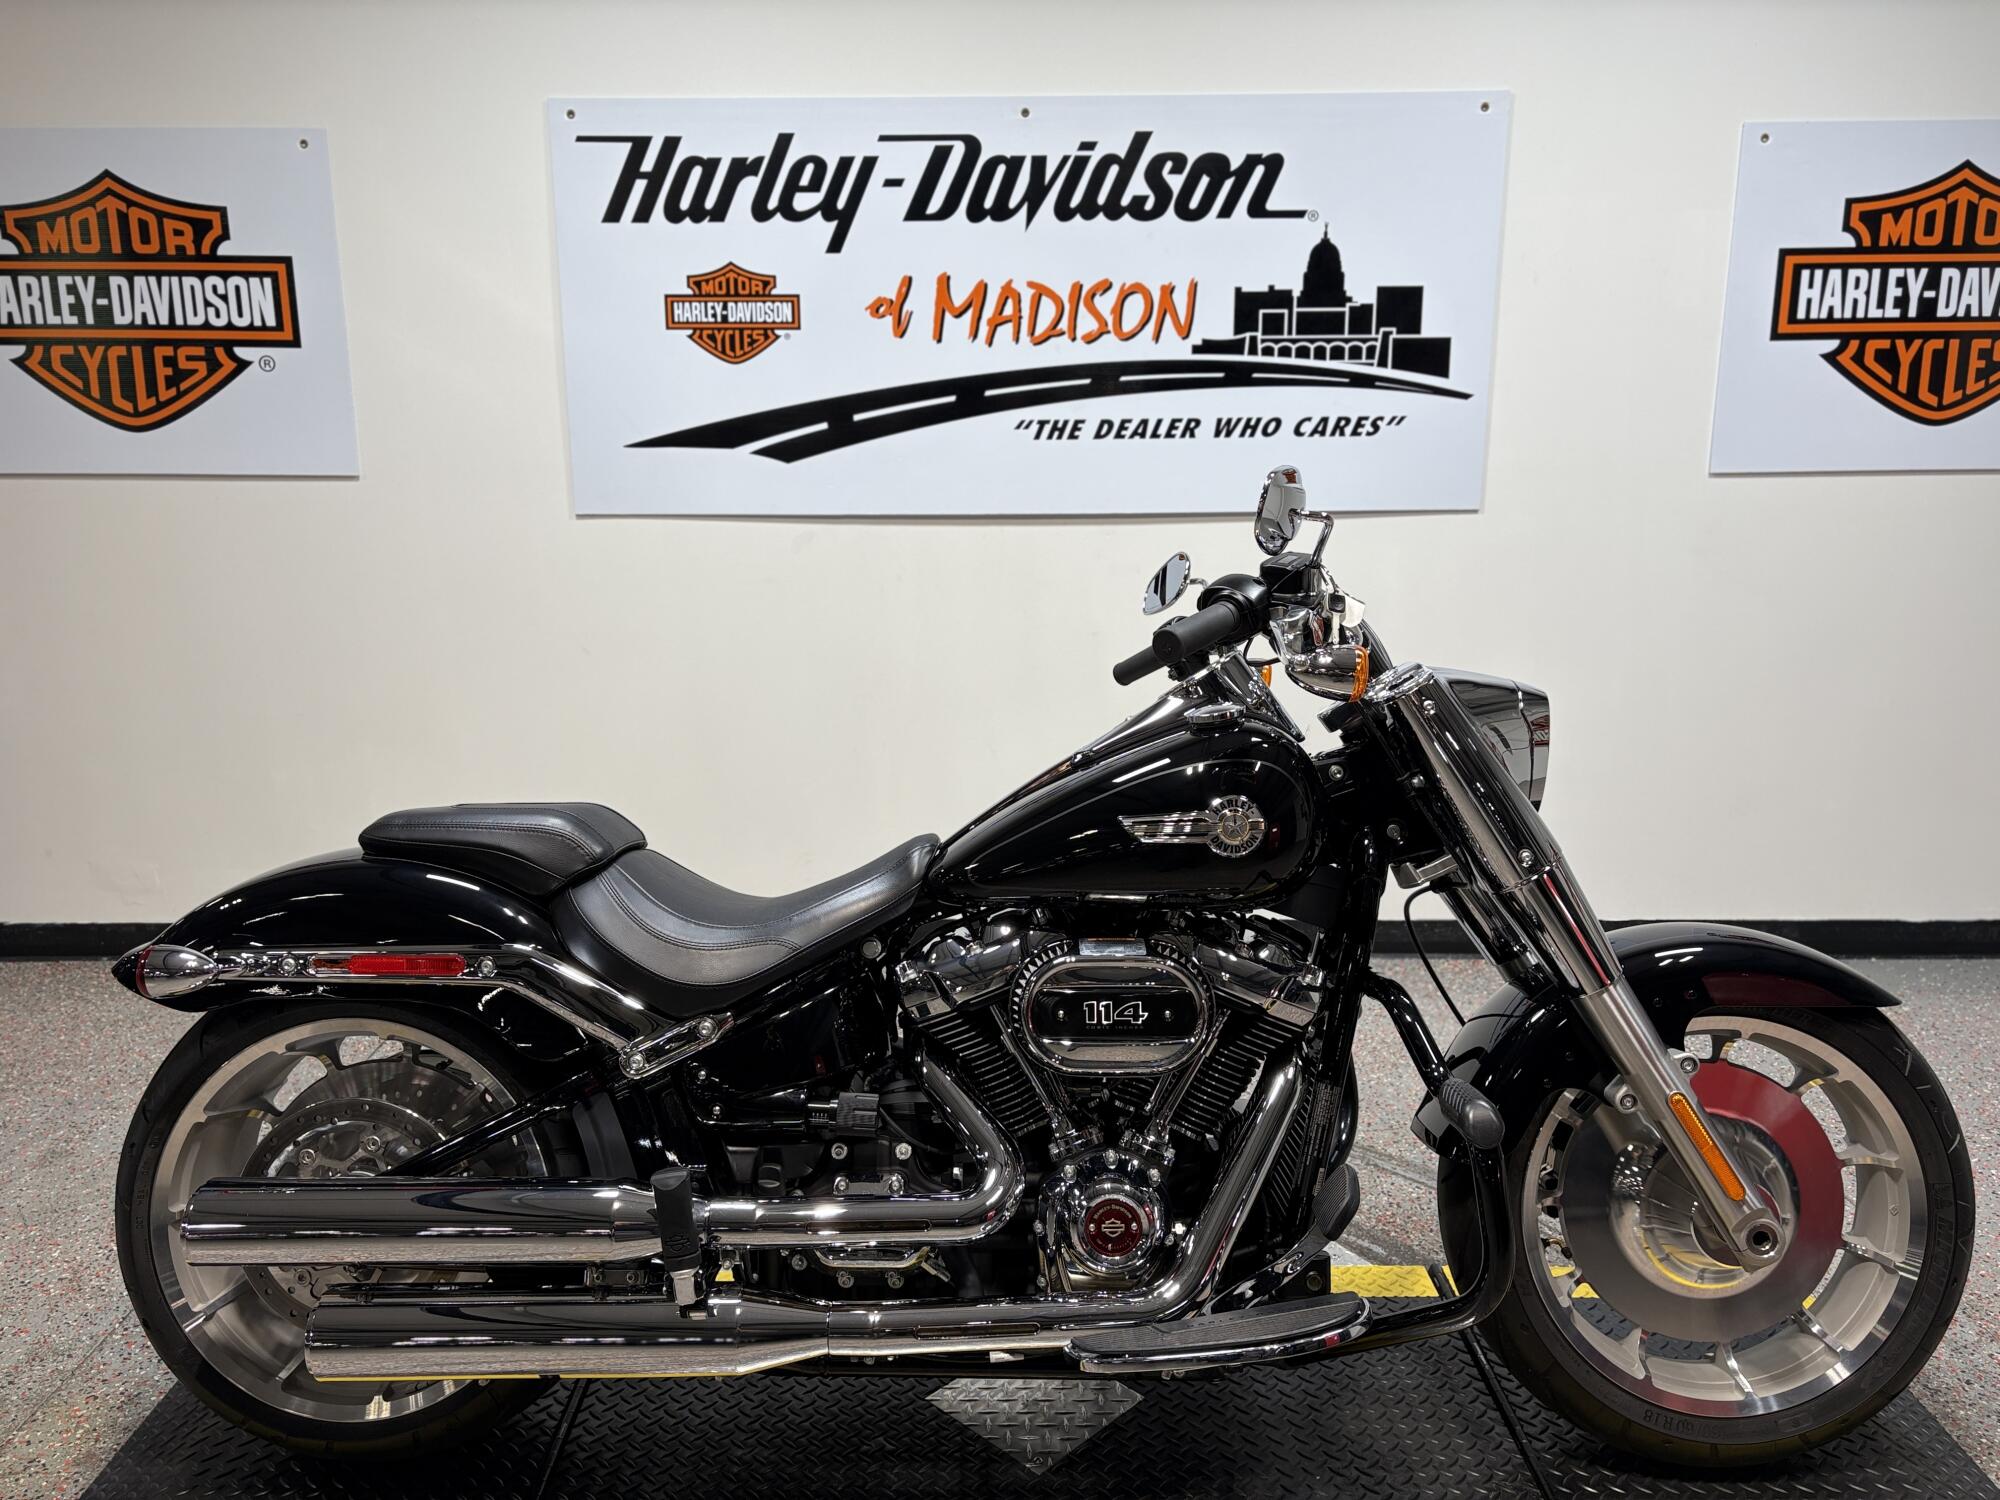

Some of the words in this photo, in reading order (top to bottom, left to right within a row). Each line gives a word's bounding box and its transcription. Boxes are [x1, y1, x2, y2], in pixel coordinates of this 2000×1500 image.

[575, 131, 1308, 253] Harley-Davidson
[36, 195, 196, 255] MOTOR
[701, 271, 763, 295] MOTOR
[1796, 267, 2000, 320] HARLEY-DAV
[673, 301, 793, 323] HARLEY-DAVIDSON
[865, 275, 912, 338] of
[932, 272, 1197, 347] MADISON
[702, 330, 764, 357] CYCLES
[51, 345, 208, 413] CYCLES
[1093, 418, 1202, 440] DEALER
[1212, 417, 1283, 439] WHO
[1210, 834, 1259, 853] DAVIDSON
[1083, 1001, 1149, 1024] 114
